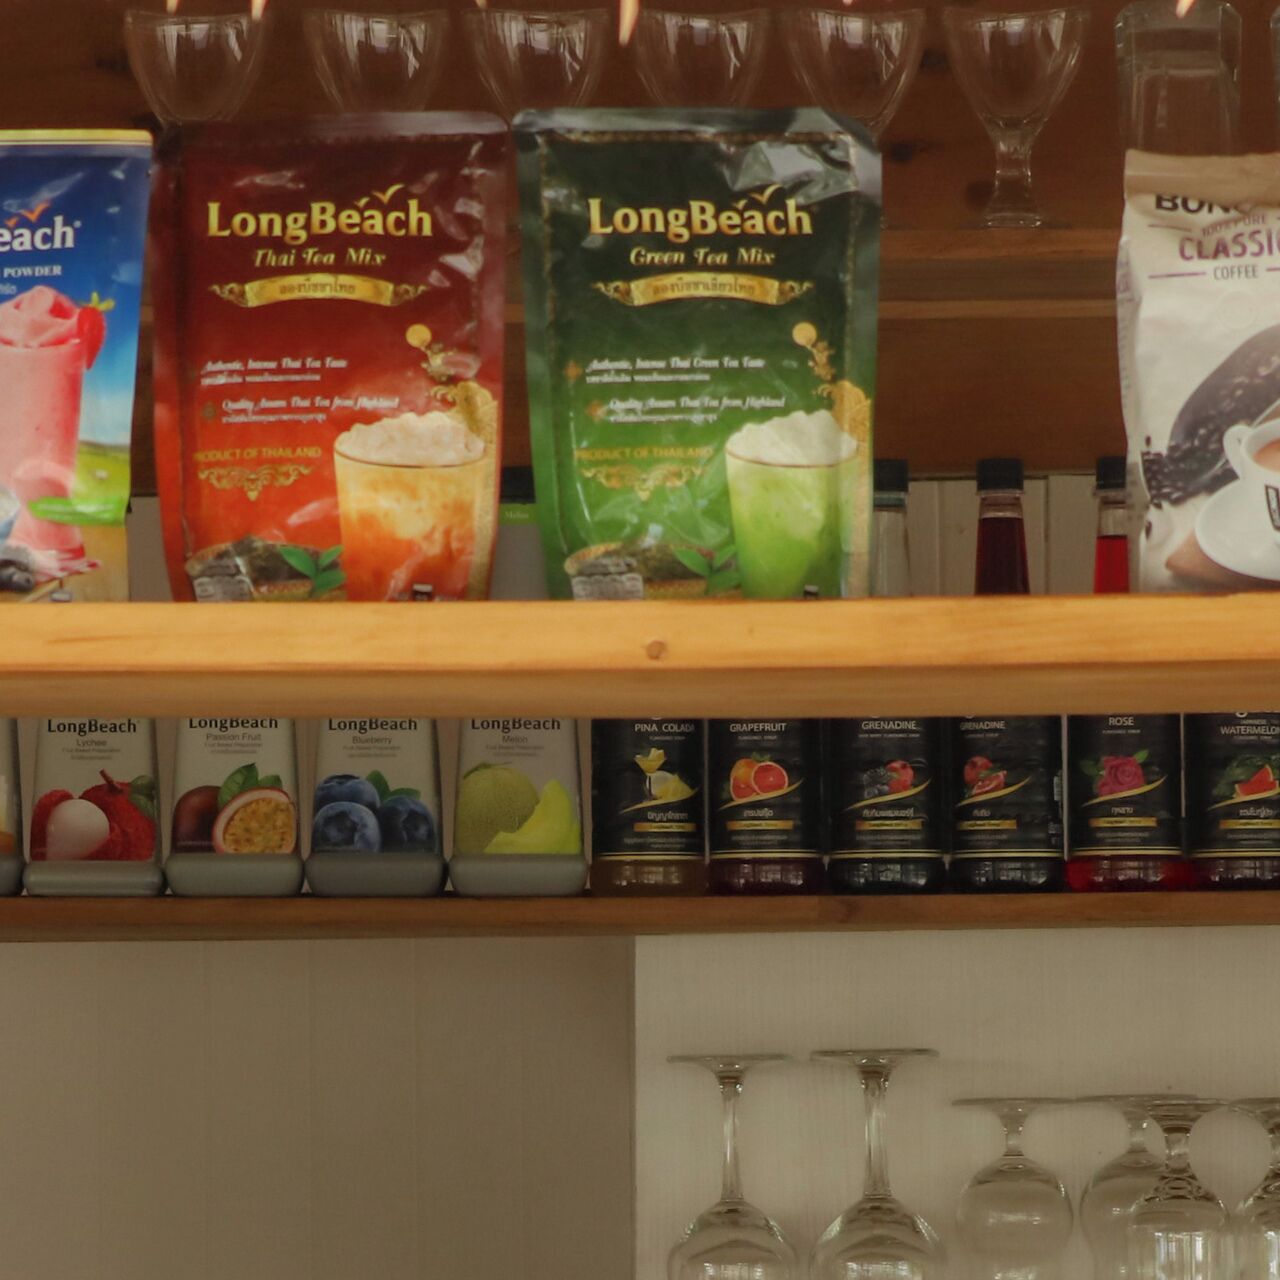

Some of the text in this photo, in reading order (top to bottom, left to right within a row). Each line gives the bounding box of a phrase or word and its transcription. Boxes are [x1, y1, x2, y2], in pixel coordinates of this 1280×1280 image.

[207, 198, 433, 245] LongBeach
[588, 198, 813, 244] LongBeach
[254, 247, 386, 267] Thai Tea Mix
[630, 246, 776, 266] Green Tea Mix
[3, 265, 62, 278] POWDER
[1213, 265, 1259, 280] COFFEE
[47, 719, 137, 736] LongBeach
[188, 718, 278, 733] LongBeach
[328, 718, 417, 734] LongBeach
[471, 718, 561, 733] LongBeach
[634, 723, 695, 733] PINA COLADA
[729, 722, 787, 733] GRAPEFRUIT
[861, 720, 917, 730] GRENADINE
[1108, 716, 1135, 726] ROSE
[75, 738, 108, 748] Lychee
[206, 732, 261, 742] Passion Fruit
[352, 735, 393, 746] Blueberry
[502, 735, 528, 744] Melon
